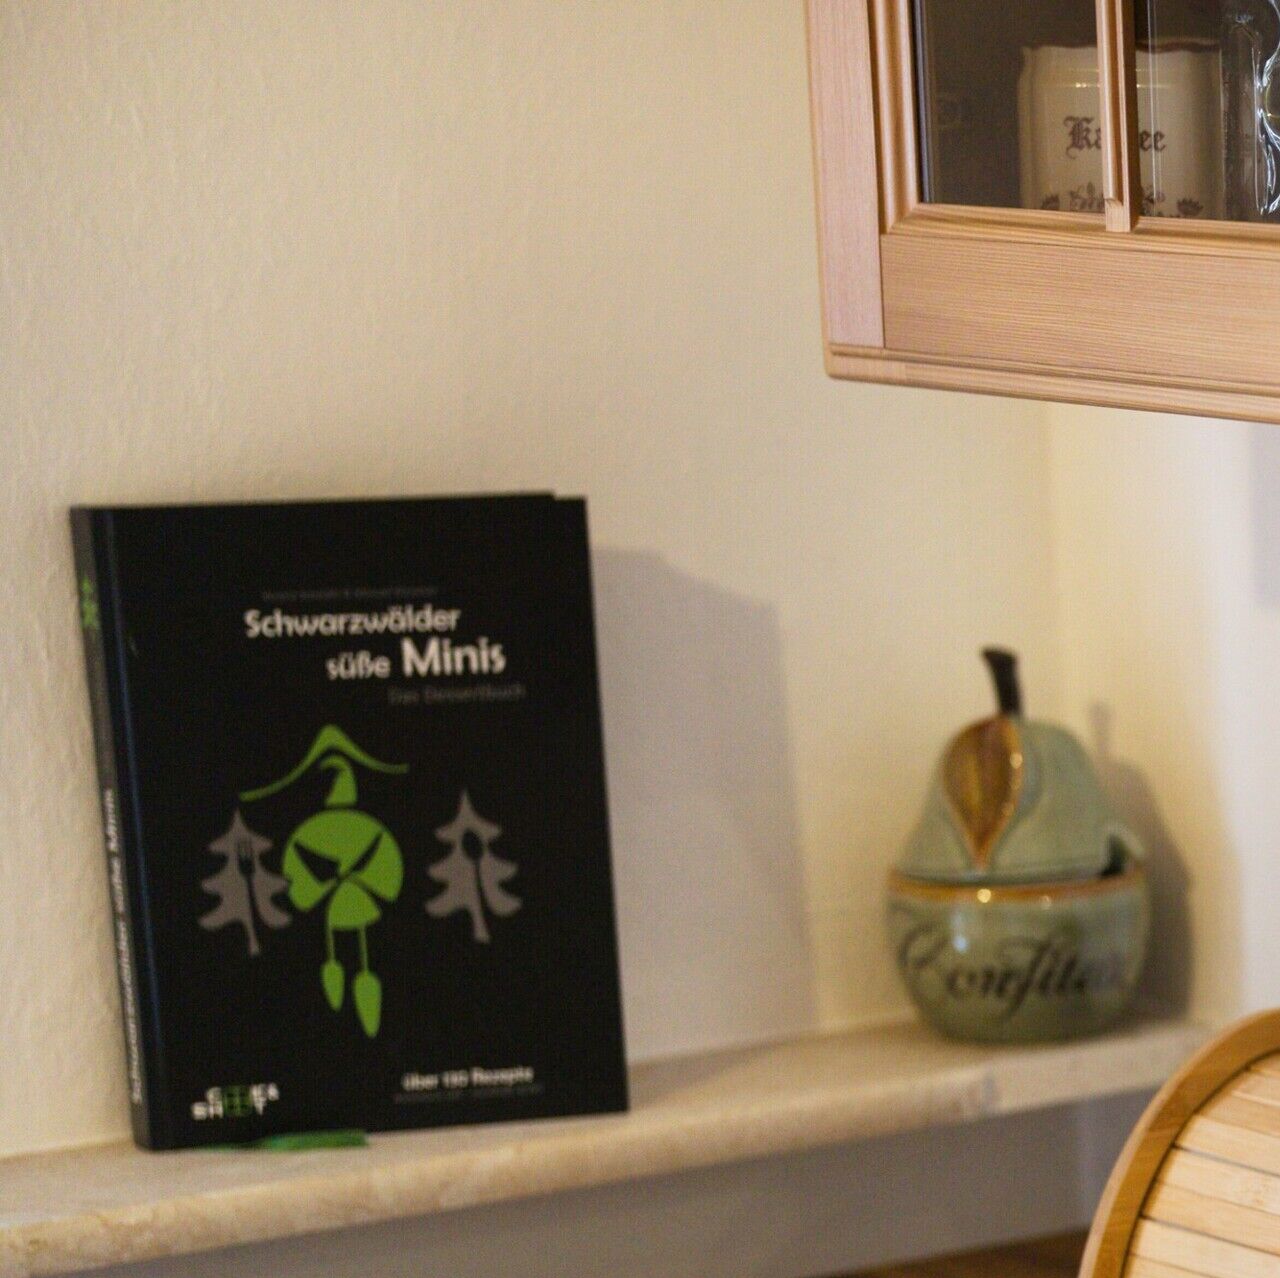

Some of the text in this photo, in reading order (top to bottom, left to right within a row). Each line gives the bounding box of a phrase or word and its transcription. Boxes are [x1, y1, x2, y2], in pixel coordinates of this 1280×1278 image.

[1063, 115, 1166, 160] Kee
[244, 603, 462, 640] Schwarzwälder
[325, 636, 507, 681] süße Minis
